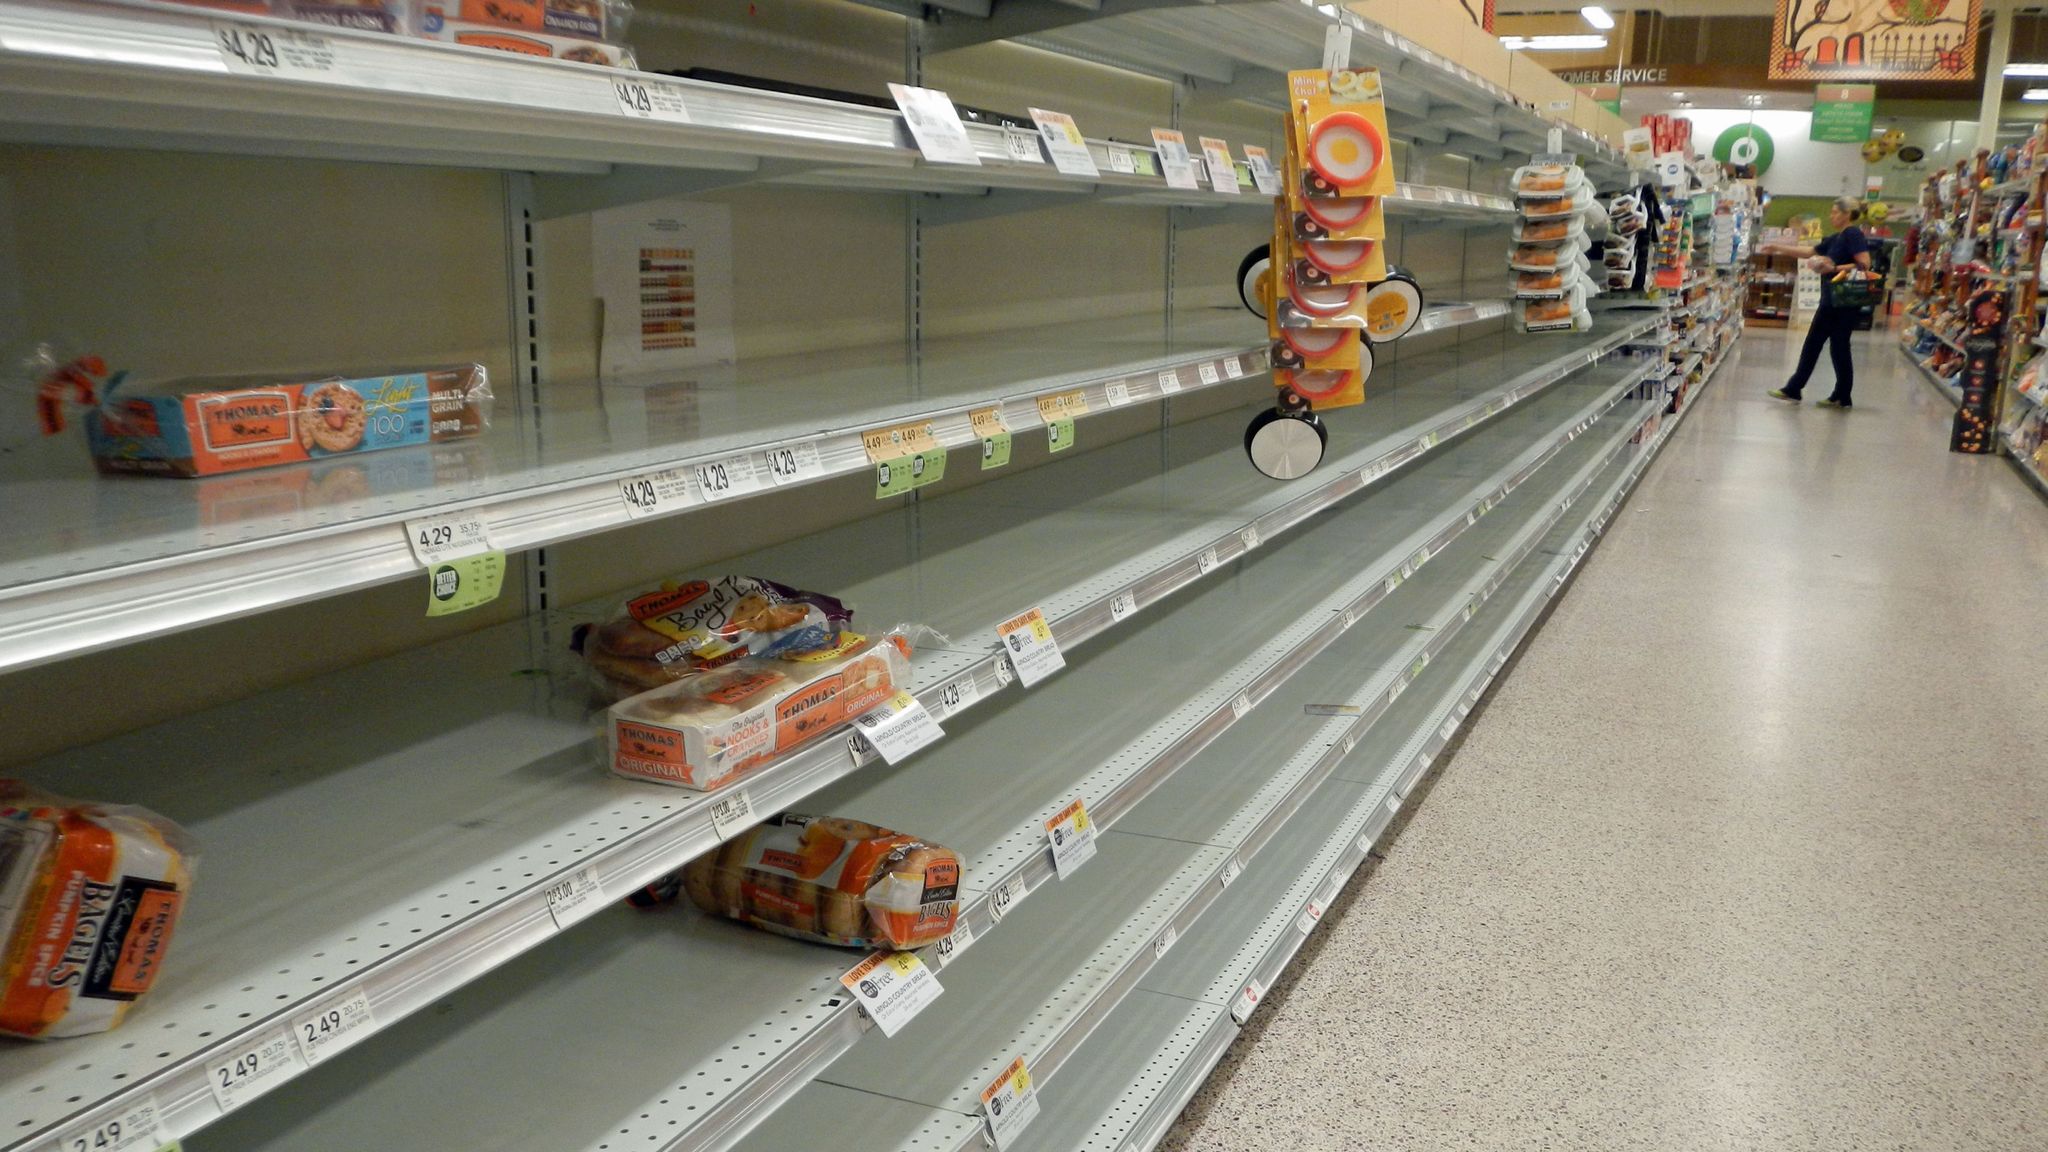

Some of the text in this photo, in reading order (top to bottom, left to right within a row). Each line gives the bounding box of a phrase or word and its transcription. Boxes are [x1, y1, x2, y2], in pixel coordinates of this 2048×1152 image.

[220, 29, 279, 68] $4.29
[1293, 76, 1316, 86] Mini
[1605, 68, 1668, 83] SERVICE
[615, 83, 652, 112] $4.29
[1841, 88, 1849, 100] 8
[432, 402, 463, 414] GRAIN
[371, 414, 404, 435] 100
[902, 429, 916, 442] 4.49
[866, 436, 881, 450] 4.49
[768, 450, 797, 476] $4.29
[697, 464, 729, 492] $4.29
[623, 480, 657, 507] $4.29
[420, 526, 452, 547] 4.29
[782, 685, 838, 722] THOMAS
[847, 689, 885, 713] ORIGINAL
[940, 683, 960, 708] $4.29
[727, 718, 769, 745] NOOKS &
[619, 755, 688, 779] ORIGINAL
[929, 864, 955, 874] THOMAS
[919, 902, 951, 922] BAGELS
[27, 870, 86, 987] PUMPKIN SPICE
[47, 879, 116, 988] BAGELS
[134, 900, 172, 982] THOMAS
[848, 967, 865, 982] LOVE
[863, 962, 872, 972] TO
[871, 972, 895, 991] Free
[874, 998, 894, 1015] ARNOLD
[892, 981, 913, 1000] COUNTRY
[912, 969, 927, 984] BREAD
[304, 1011, 340, 1043] 2.49
[218, 1053, 258, 1088] 2.49
